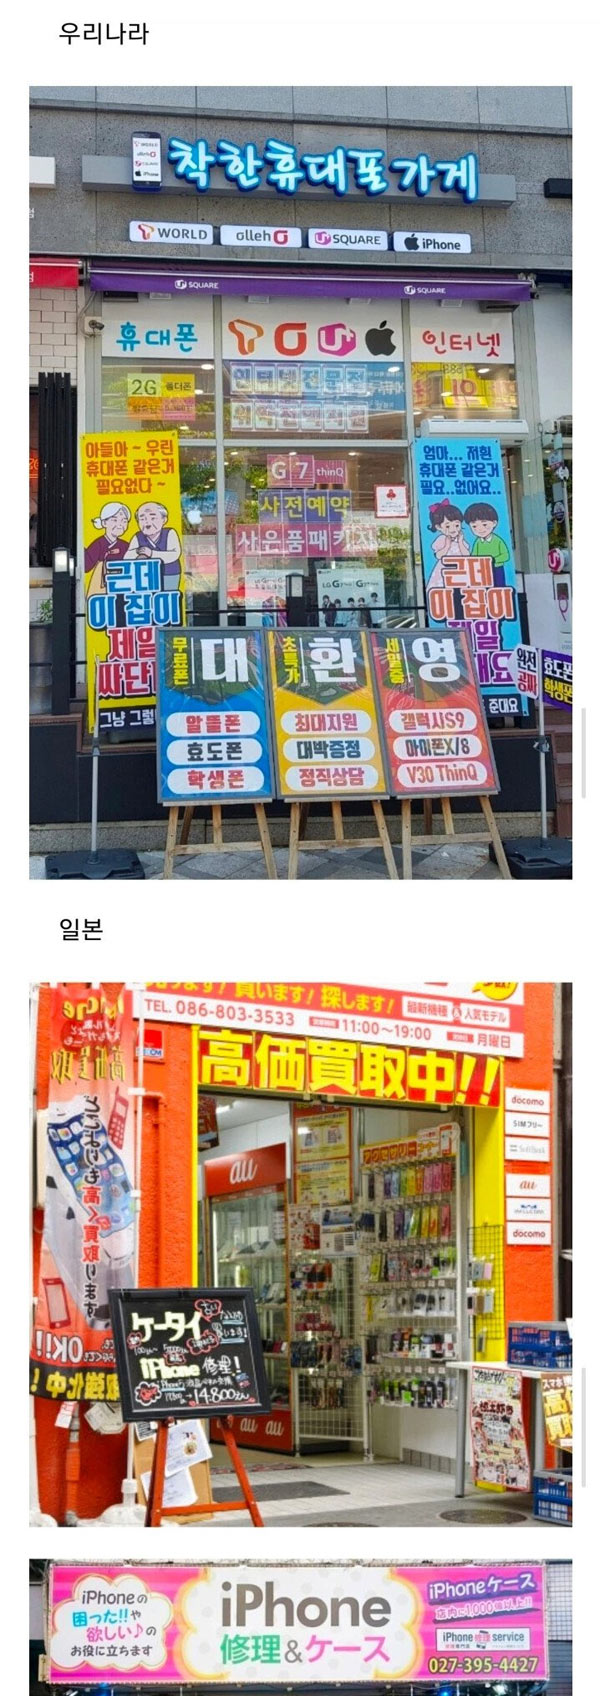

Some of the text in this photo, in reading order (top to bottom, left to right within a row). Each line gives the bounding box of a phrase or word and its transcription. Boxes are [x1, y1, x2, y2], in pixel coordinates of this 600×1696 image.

[158, 228, 208, 240] WORLD
[236, 230, 271, 242] olleh
[333, 233, 381, 245] SQUARE
[422, 238, 461, 251] iPhone
[189, 281, 218, 289] SQUARE
[116, 322, 197, 352] 휴대폰
[422, 330, 500, 357] 인터넷
[131, 380, 157, 396] 2G
[86, 440, 174, 458] 아들아 우린
[467, 446, 492, 460] 저흰
[87, 458, 174, 477] 휴대폰 같은거
[316, 467, 344, 478] thinQ
[96, 478, 151, 495] 필요없다
[260, 494, 350, 519] 사전예약
[105, 560, 161, 593] 근데
[186, 716, 240, 733] 알뜰폰
[295, 713, 358, 732] 최대지원
[401, 713, 465, 730] 갤럭시S9
[187, 742, 242, 761] 효도폰
[297, 740, 361, 759] 대박증정
[405, 739, 470, 756] 아이폰X/8
[187, 770, 244, 789] 학생폰
[300, 767, 364, 787] 정직상담
[407, 764, 478, 784] V30 ThinQ
[176, 1000, 295, 1025] 086-803-3533
[477, 1034, 511, 1049] 月曜日
[512, 1095, 544, 1106] docomo
[513, 1120, 543, 1128] SIMフリー
[229, 1159, 257, 1184] au
[131, 1311, 200, 1342] ケータイ
[429, 1573, 535, 1599] iPhoneケース
[220, 1581, 392, 1627] iPhone
[70, 1645, 152, 1657] お役に立ちます
[429, 1657, 538, 1673] 027-395-4427
